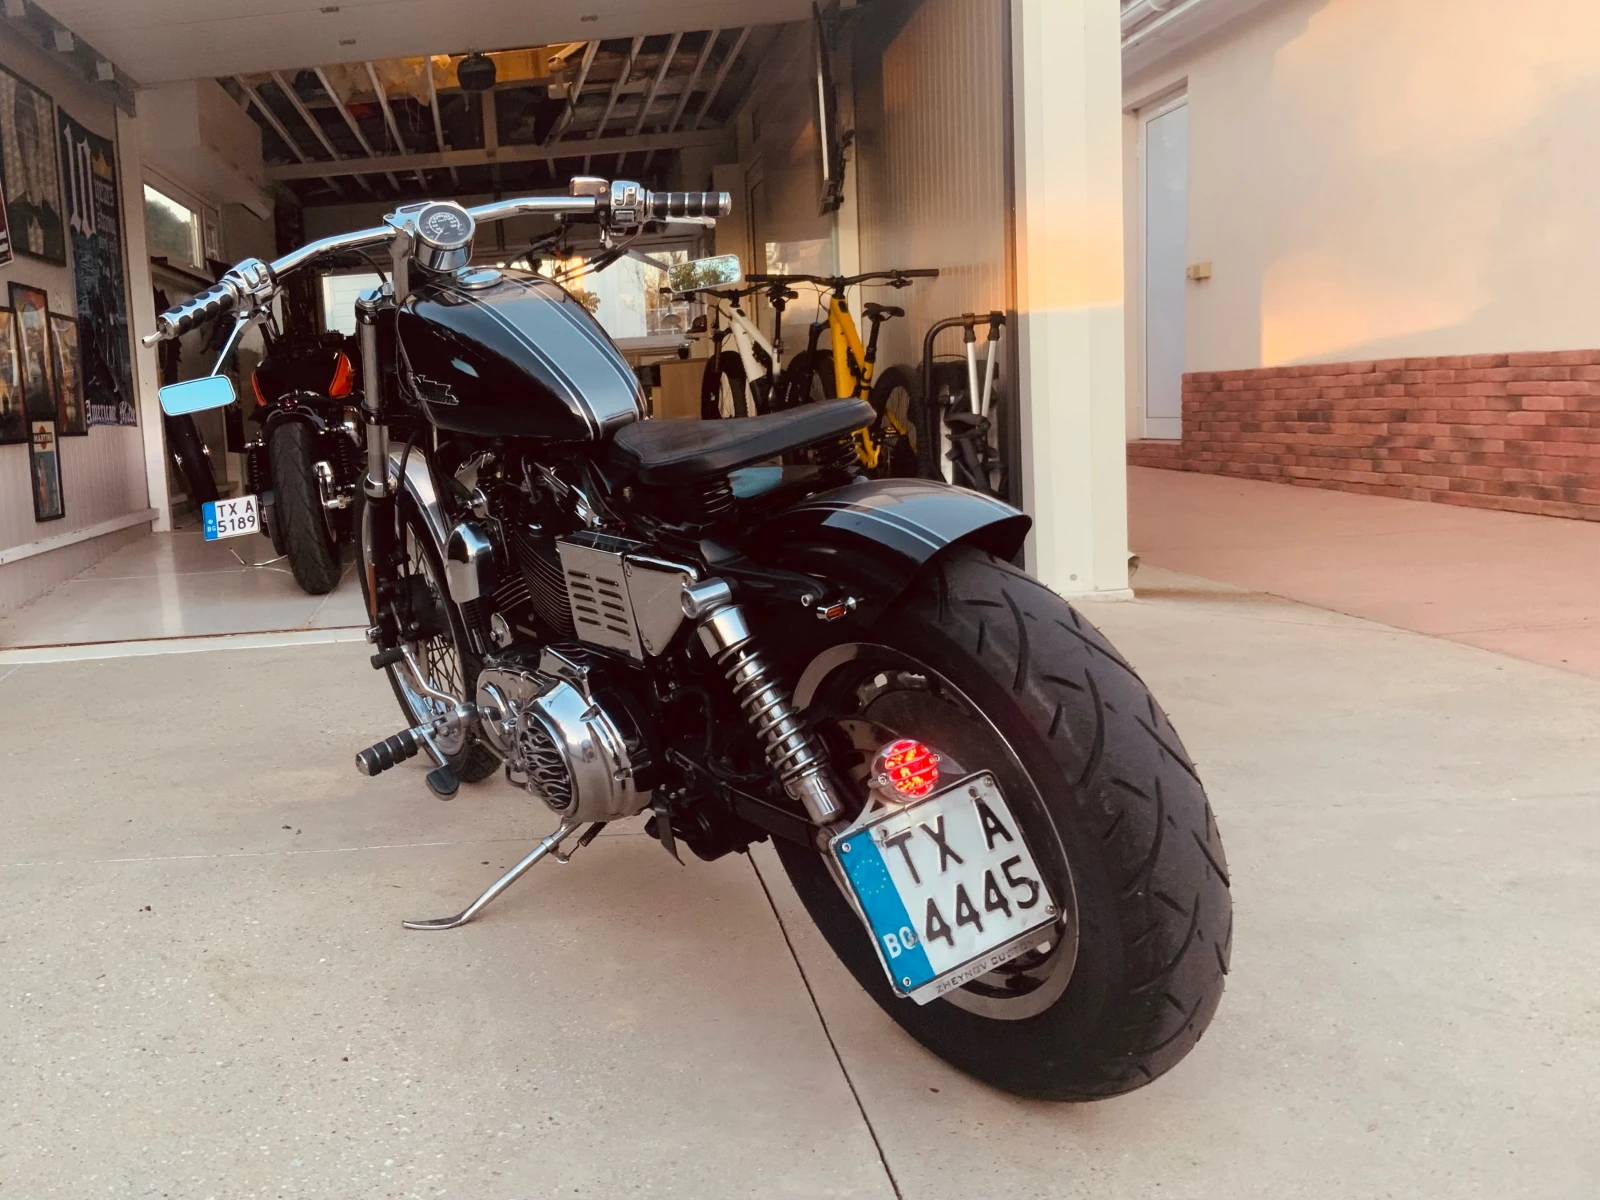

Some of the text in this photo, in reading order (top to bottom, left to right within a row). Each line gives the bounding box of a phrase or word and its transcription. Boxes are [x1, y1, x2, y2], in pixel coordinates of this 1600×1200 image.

[217, 500, 254, 518] TX A
[207, 525, 217, 533] BG
[218, 515, 256, 533] 5189
[884, 797, 1014, 885] TX A
[925, 854, 1040, 947] 4445
[935, 961, 988, 994] ZHEYNOV
